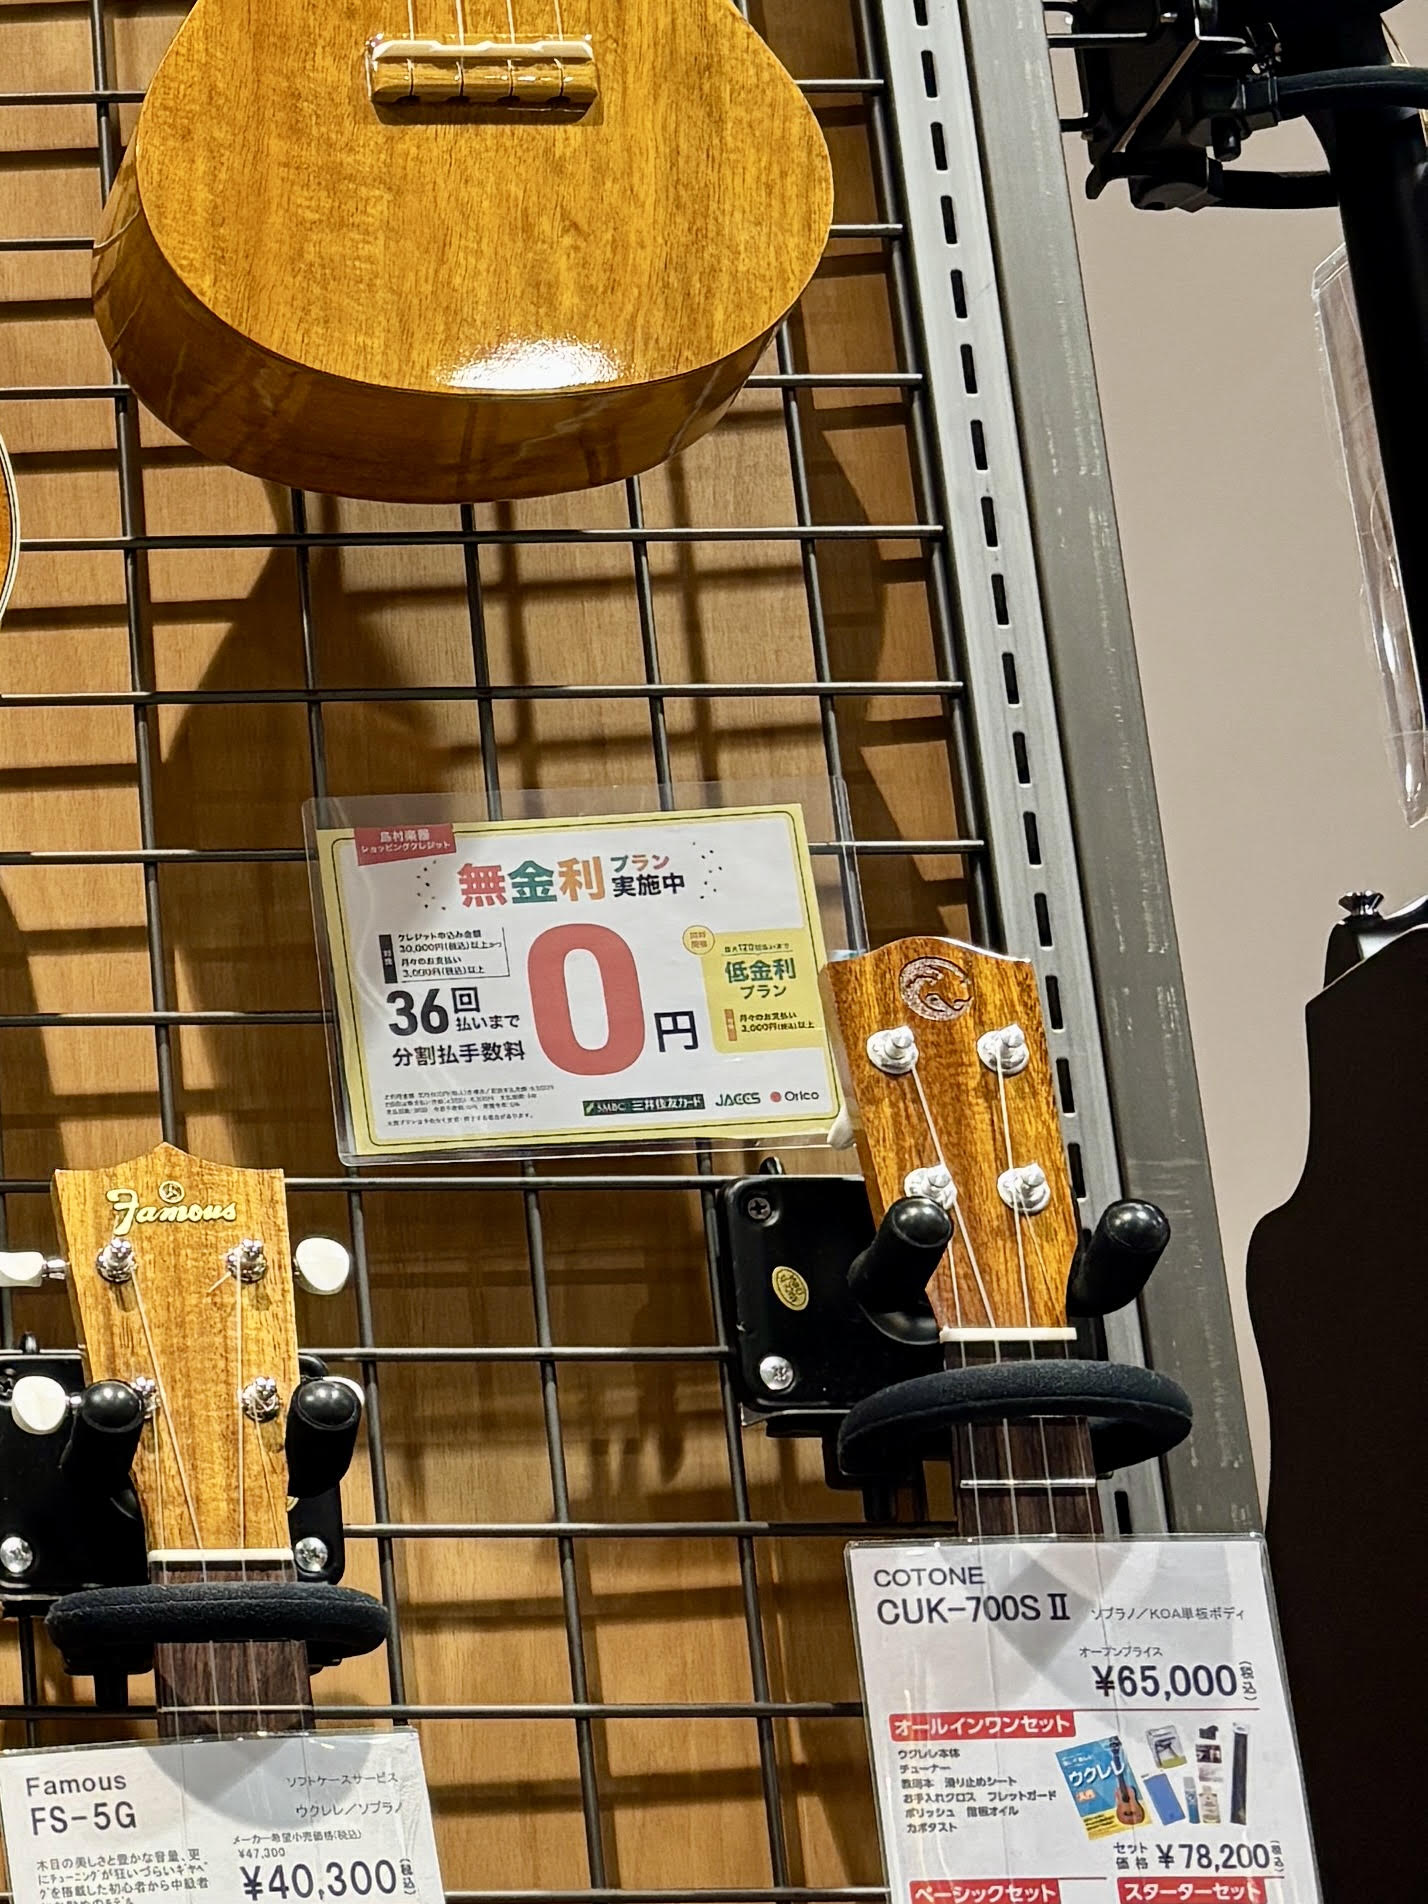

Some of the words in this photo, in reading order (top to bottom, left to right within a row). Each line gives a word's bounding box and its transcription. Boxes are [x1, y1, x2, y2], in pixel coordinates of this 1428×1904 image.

[610, 854, 670, 873] プラン
[457, 856, 606, 907] 無金利
[612, 872, 685, 897] 実施中
[725, 957, 796, 983] 低金利
[740, 984, 787, 1000] プラン
[455, 1014, 520, 1031] 払いまで
[392, 1040, 525, 1067] 分割払手数料
[715, 1092, 761, 1107] JACCS
[784, 1090, 820, 1102] Orico
[106, 1187, 237, 1237] Famous
[872, 1566, 985, 1588] COTONE
[1078, 1645, 1163, 1659] オープンプライス
[1091, 1662, 1239, 1700] ¥65,000
[893, 1716, 1071, 1737] オールインワンセット
[25, 1770, 127, 1797] Famous
[285, 1770, 399, 1791] ソフトケースサービス
[29, 1800, 137, 1837] FS-5G
[1156, 1842, 1272, 1872] ¥78,200
[239, 1857, 399, 1904] ¥40,300
[913, 1884, 1057, 1904] ベーシックセット
[1123, 1882, 1264, 1902] スターターセット
